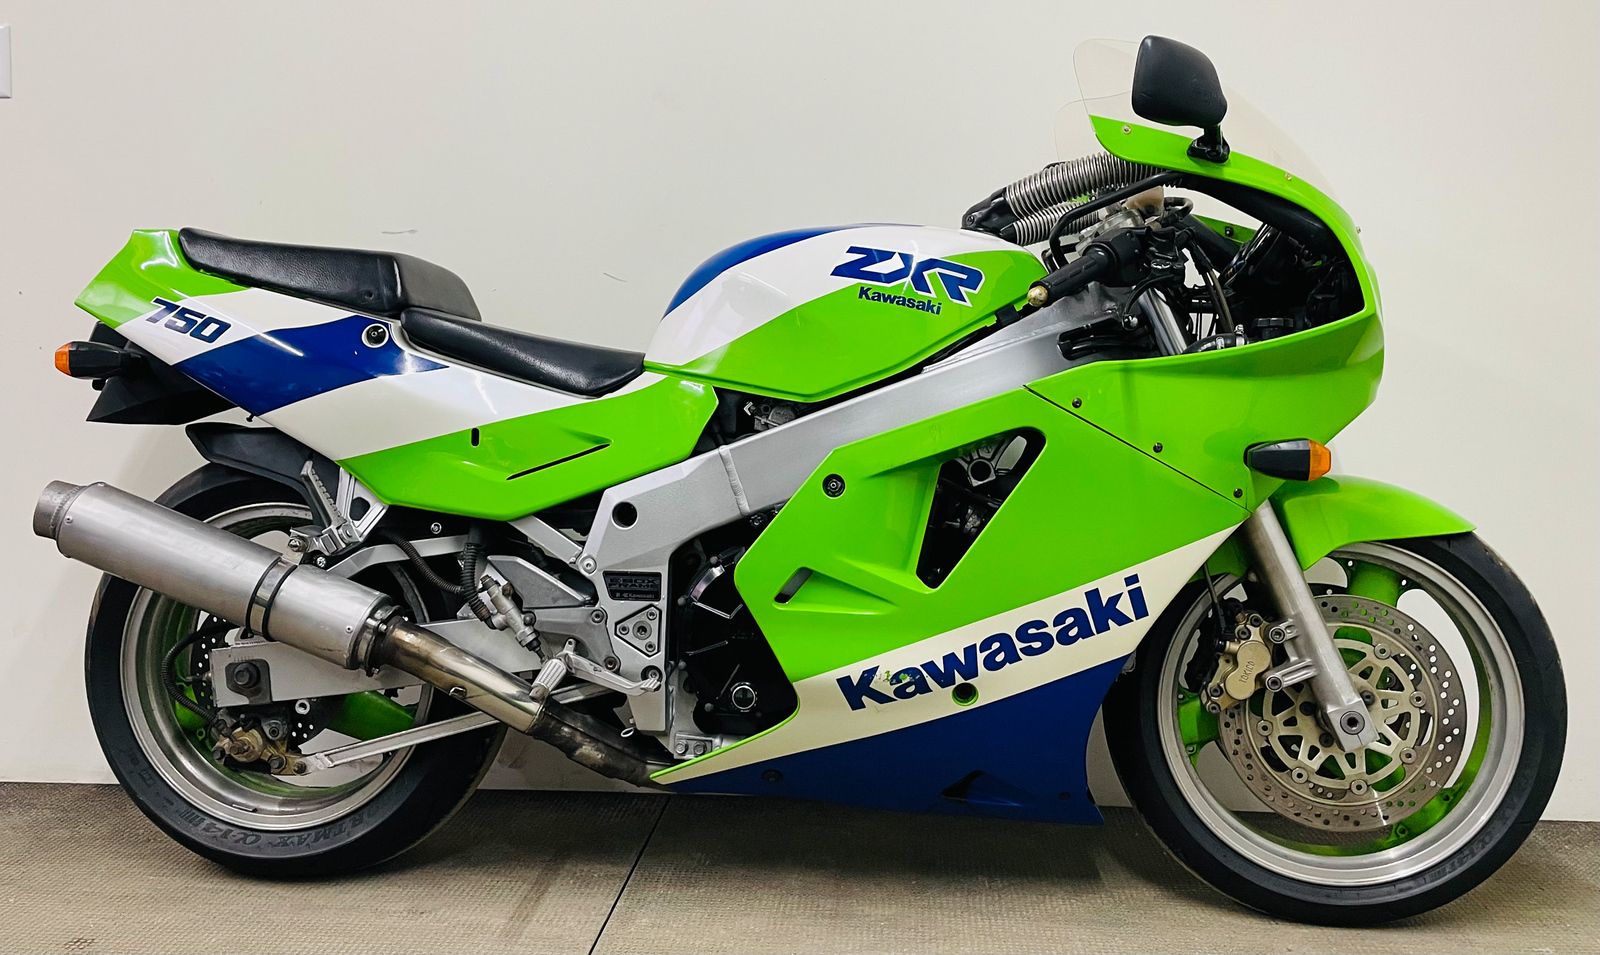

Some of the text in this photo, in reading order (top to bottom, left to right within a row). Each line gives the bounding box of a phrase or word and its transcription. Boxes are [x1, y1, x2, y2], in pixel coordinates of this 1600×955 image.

[830, 246, 984, 305] ZXR
[145, 297, 232, 344] 750
[857, 286, 943, 316] Kawasaki
[836, 573, 1150, 712] Kawasaki
[1238, 659, 1255, 684] TOKICO
